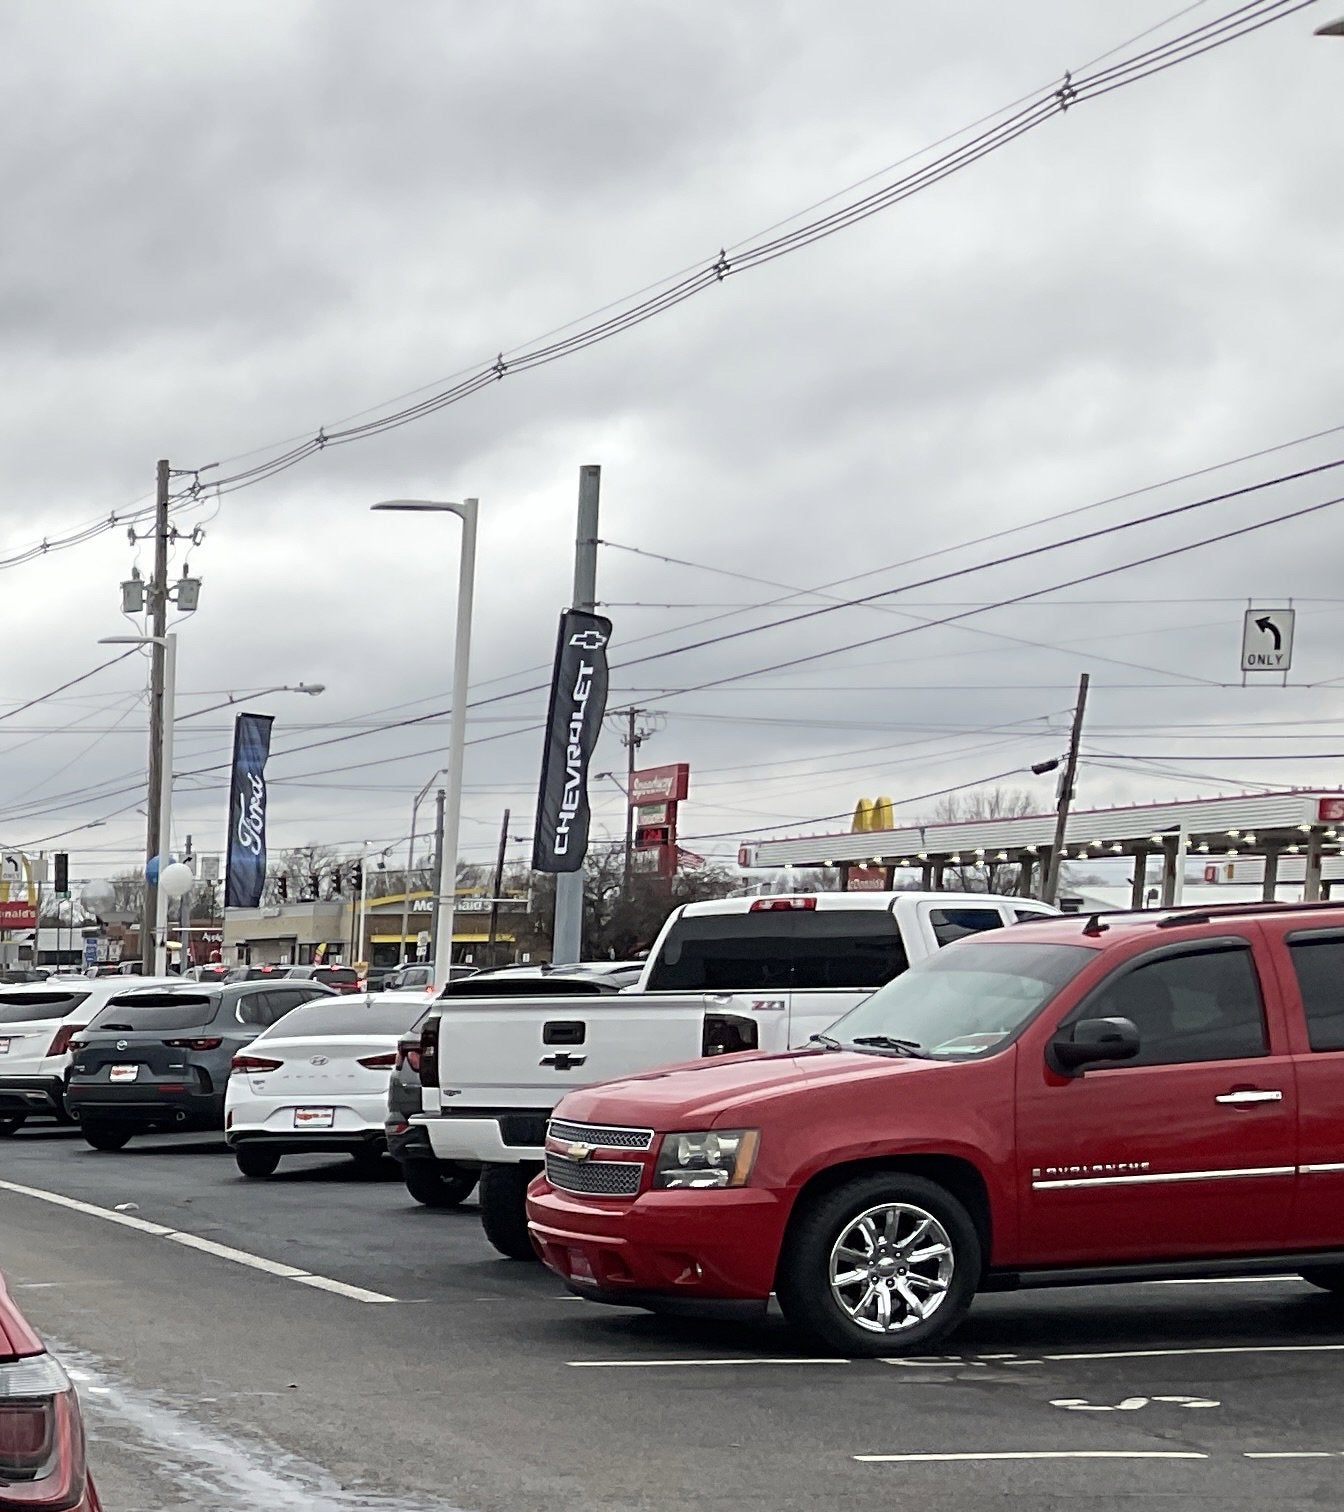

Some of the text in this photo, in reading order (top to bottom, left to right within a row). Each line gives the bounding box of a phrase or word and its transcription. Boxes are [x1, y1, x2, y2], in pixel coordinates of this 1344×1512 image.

[1247, 653, 1284, 666] ONLY
[554, 660, 594, 855] CHEVROLET
[238, 772, 264, 856] Ford
